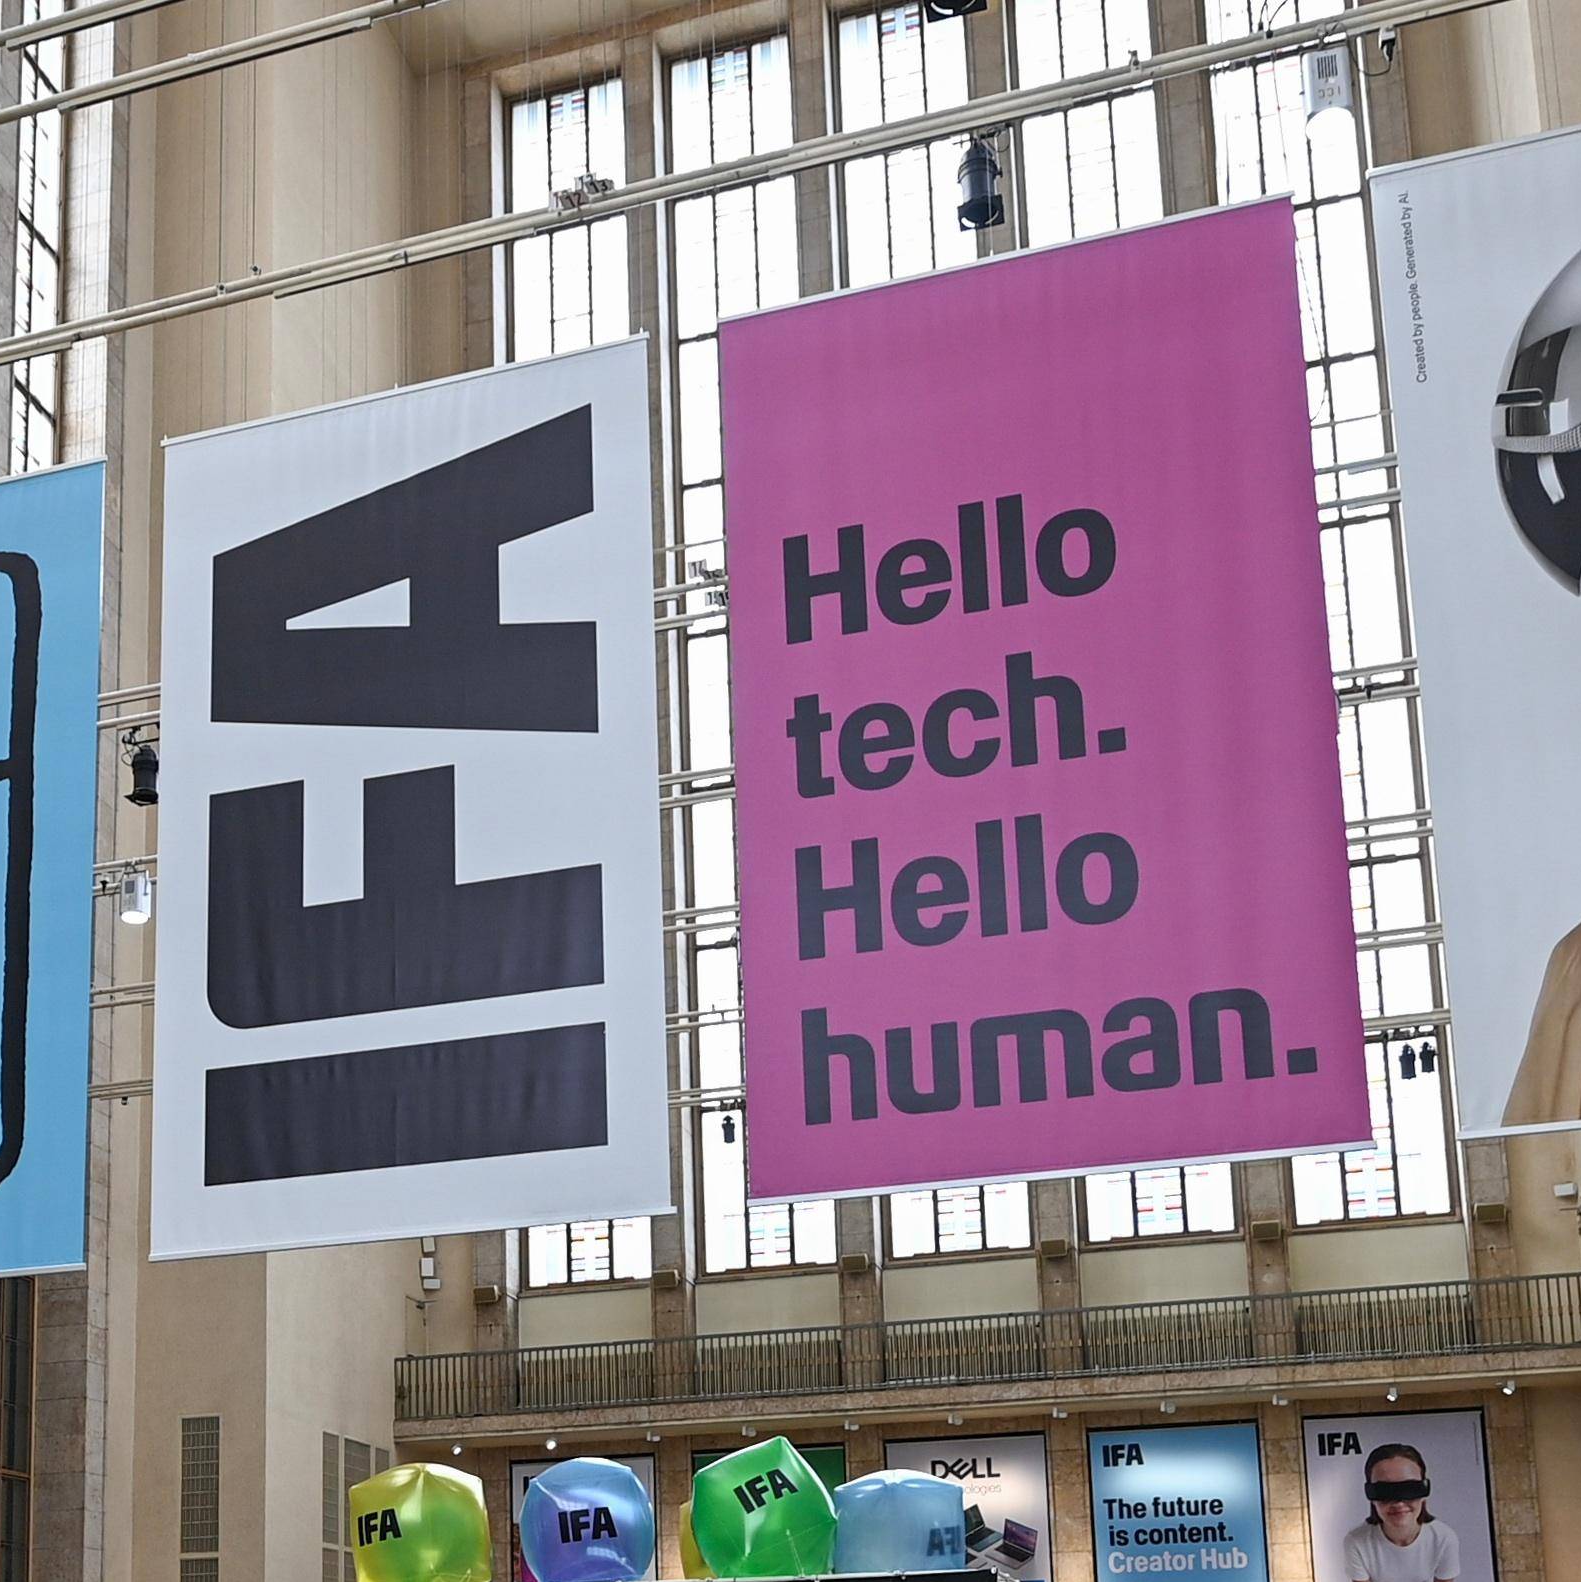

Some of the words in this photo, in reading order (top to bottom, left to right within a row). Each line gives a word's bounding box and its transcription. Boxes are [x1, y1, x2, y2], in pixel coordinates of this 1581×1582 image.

[1401, 206, 1413, 221] by
[1401, 220, 1417, 280] Generated
[1409, 281, 1423, 321] people.
[1412, 322, 1424, 337] by
[1412, 338, 1428, 383] Created
[783, 494, 1117, 645] Hello
[787, 651, 1126, 798] tech.
[205, 404, 608, 1186] IFA
[794, 814, 1139, 960] Hello
[801, 988, 1318, 1125] human.
[1102, 1443, 1144, 1468] IFA
[1318, 1432, 1362, 1457] IFA
[930, 1457, 1001, 1480] DELL
[732, 1468, 799, 1515] IFA
[965, 1483, 1002, 1496] ologies
[1103, 1497, 1148, 1521] The
[1152, 1495, 1224, 1519] future
[357, 1509, 403, 1547] IFA
[558, 1507, 618, 1544] IFA
[1108, 1523, 1129, 1547] is
[1133, 1521, 1234, 1546] content.
[1108, 1548, 1196, 1574] Creator
[1200, 1547, 1248, 1570] Hub
